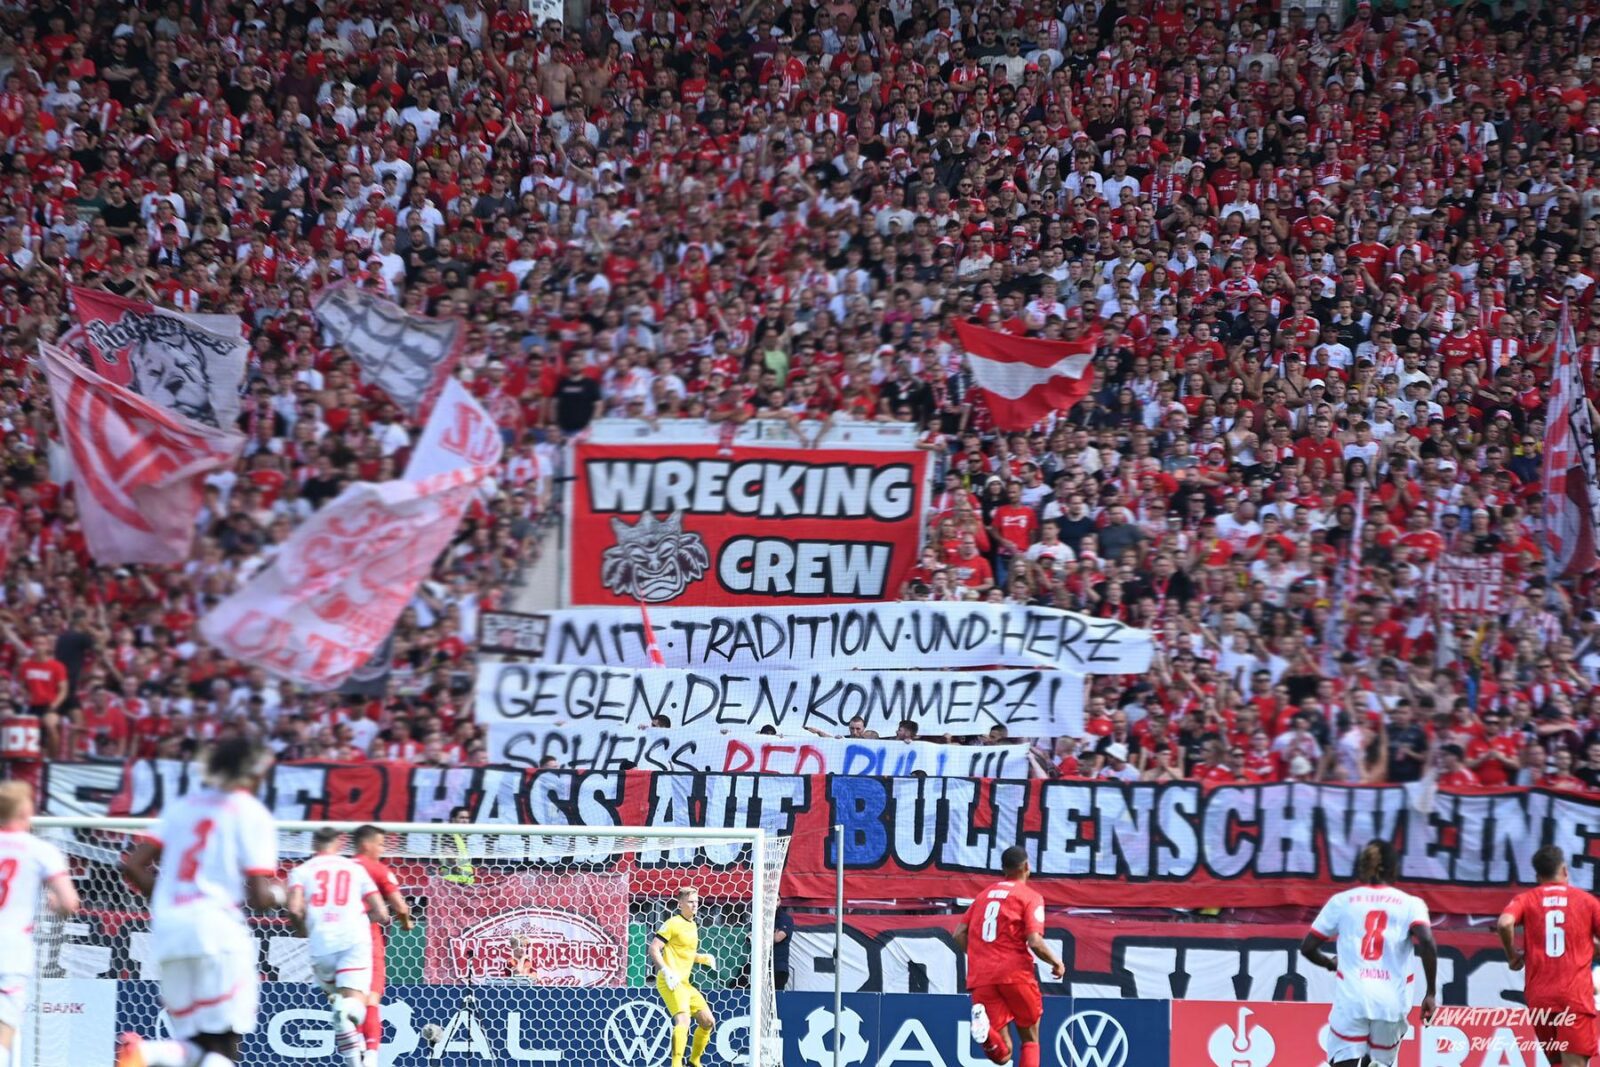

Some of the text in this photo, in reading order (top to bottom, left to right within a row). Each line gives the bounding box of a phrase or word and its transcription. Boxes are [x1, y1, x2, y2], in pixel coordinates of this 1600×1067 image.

[586, 459, 914, 518] WRECKING
[719, 536, 893, 597] CREW
[1438, 584, 1501, 611] RWE
[556, 621, 666, 663] MIT
[671, 609, 904, 663] TRADITION
[911, 609, 989, 654] UND
[999, 611, 1126, 664] HERZ
[495, 665, 674, 724] GEGEN
[682, 673, 797, 726] DEN
[410, 767, 624, 868] HASS
[636, 771, 809, 869] AUF
[828, 774, 1600, 889] BULLENSCHWEINE
[311, 869, 350, 907] 30
[982, 901, 1001, 943] 8
[1361, 910, 1388, 960] 8
[1545, 910, 1565, 957] 6
[42, 1002, 85, 1014] BANK
